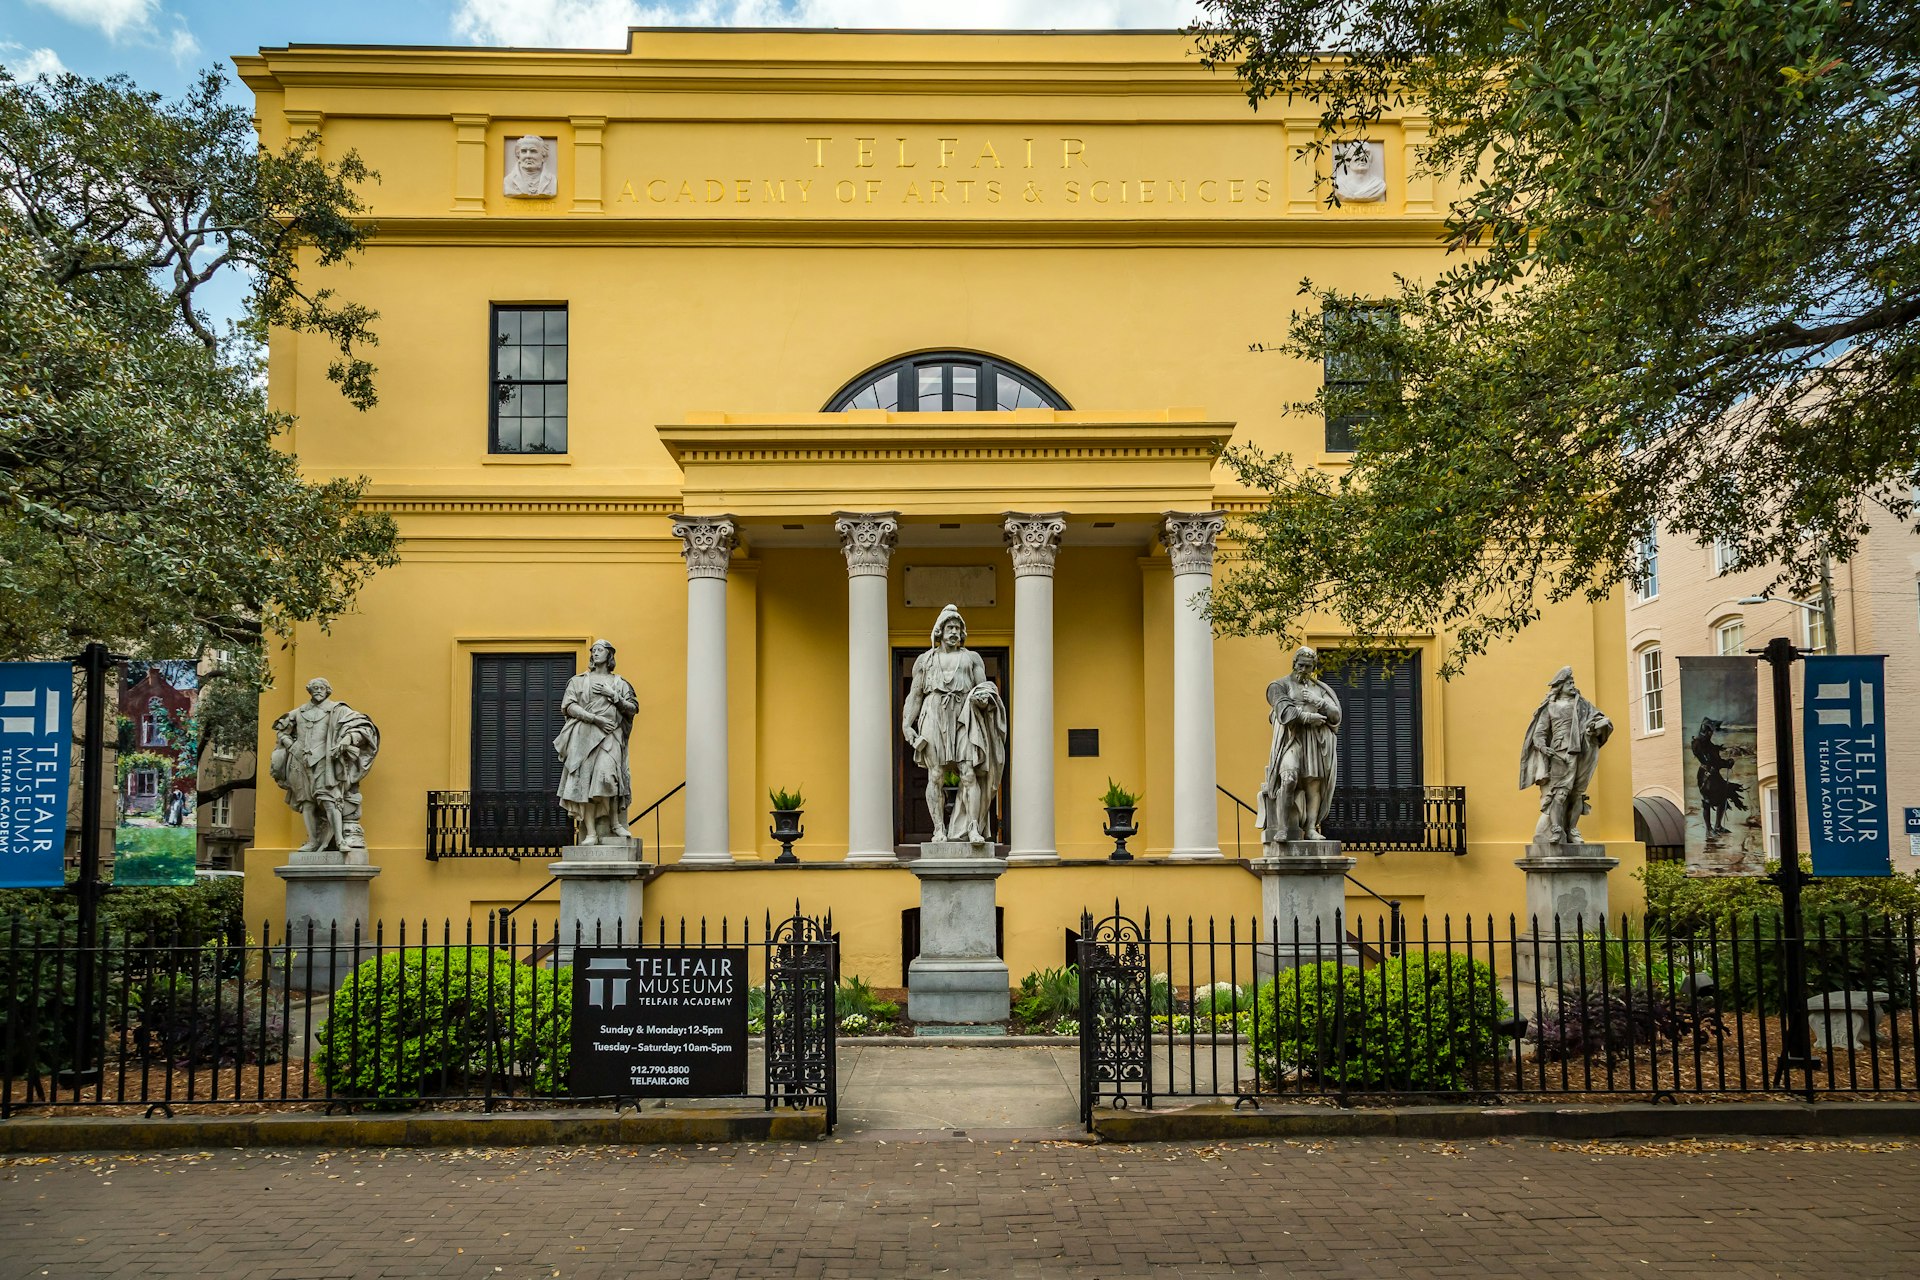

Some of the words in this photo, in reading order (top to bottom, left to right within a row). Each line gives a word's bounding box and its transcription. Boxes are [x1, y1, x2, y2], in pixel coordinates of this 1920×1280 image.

[805, 137, 1089, 169] TELFAIR
[616, 178, 813, 203] ACADEMY
[835, 178, 882, 203] OF
[902, 179, 1002, 204] ARTS
[1022, 180, 1043, 204] &
[1064, 179, 1272, 204] SCIENCES
[1, 748, 12, 793] TELFAIR
[1819, 740, 1830, 784] TELFAIR
[12, 747, 34, 854] MUSEUMS
[33, 742, 58, 852] TELFAIR
[1834, 739, 1855, 843] MUSEUMS
[1855, 734, 1878, 842] TELFAIR
[0, 797, 11, 854] ACADEMY
[1821, 788, 1834, 843] ACADEMY
[635, 958, 733, 977] TELFAIR
[638, 997, 679, 1006] TELFAIR
[682, 997, 733, 1006] ACADEMY
[639, 978, 733, 994] MUSEUMS
[600, 1025, 634, 1036] Sunday
[636, 1026, 645, 1035] &
[646, 1025, 687, 1036] Monday:
[688, 1025, 723, 1036] 12-5pm
[683, 1043, 732, 1054] 10am-5pm
[630, 1065, 690, 1074] 912.790.8800
[630, 1077, 690, 1085] TELFAIR.ORG
